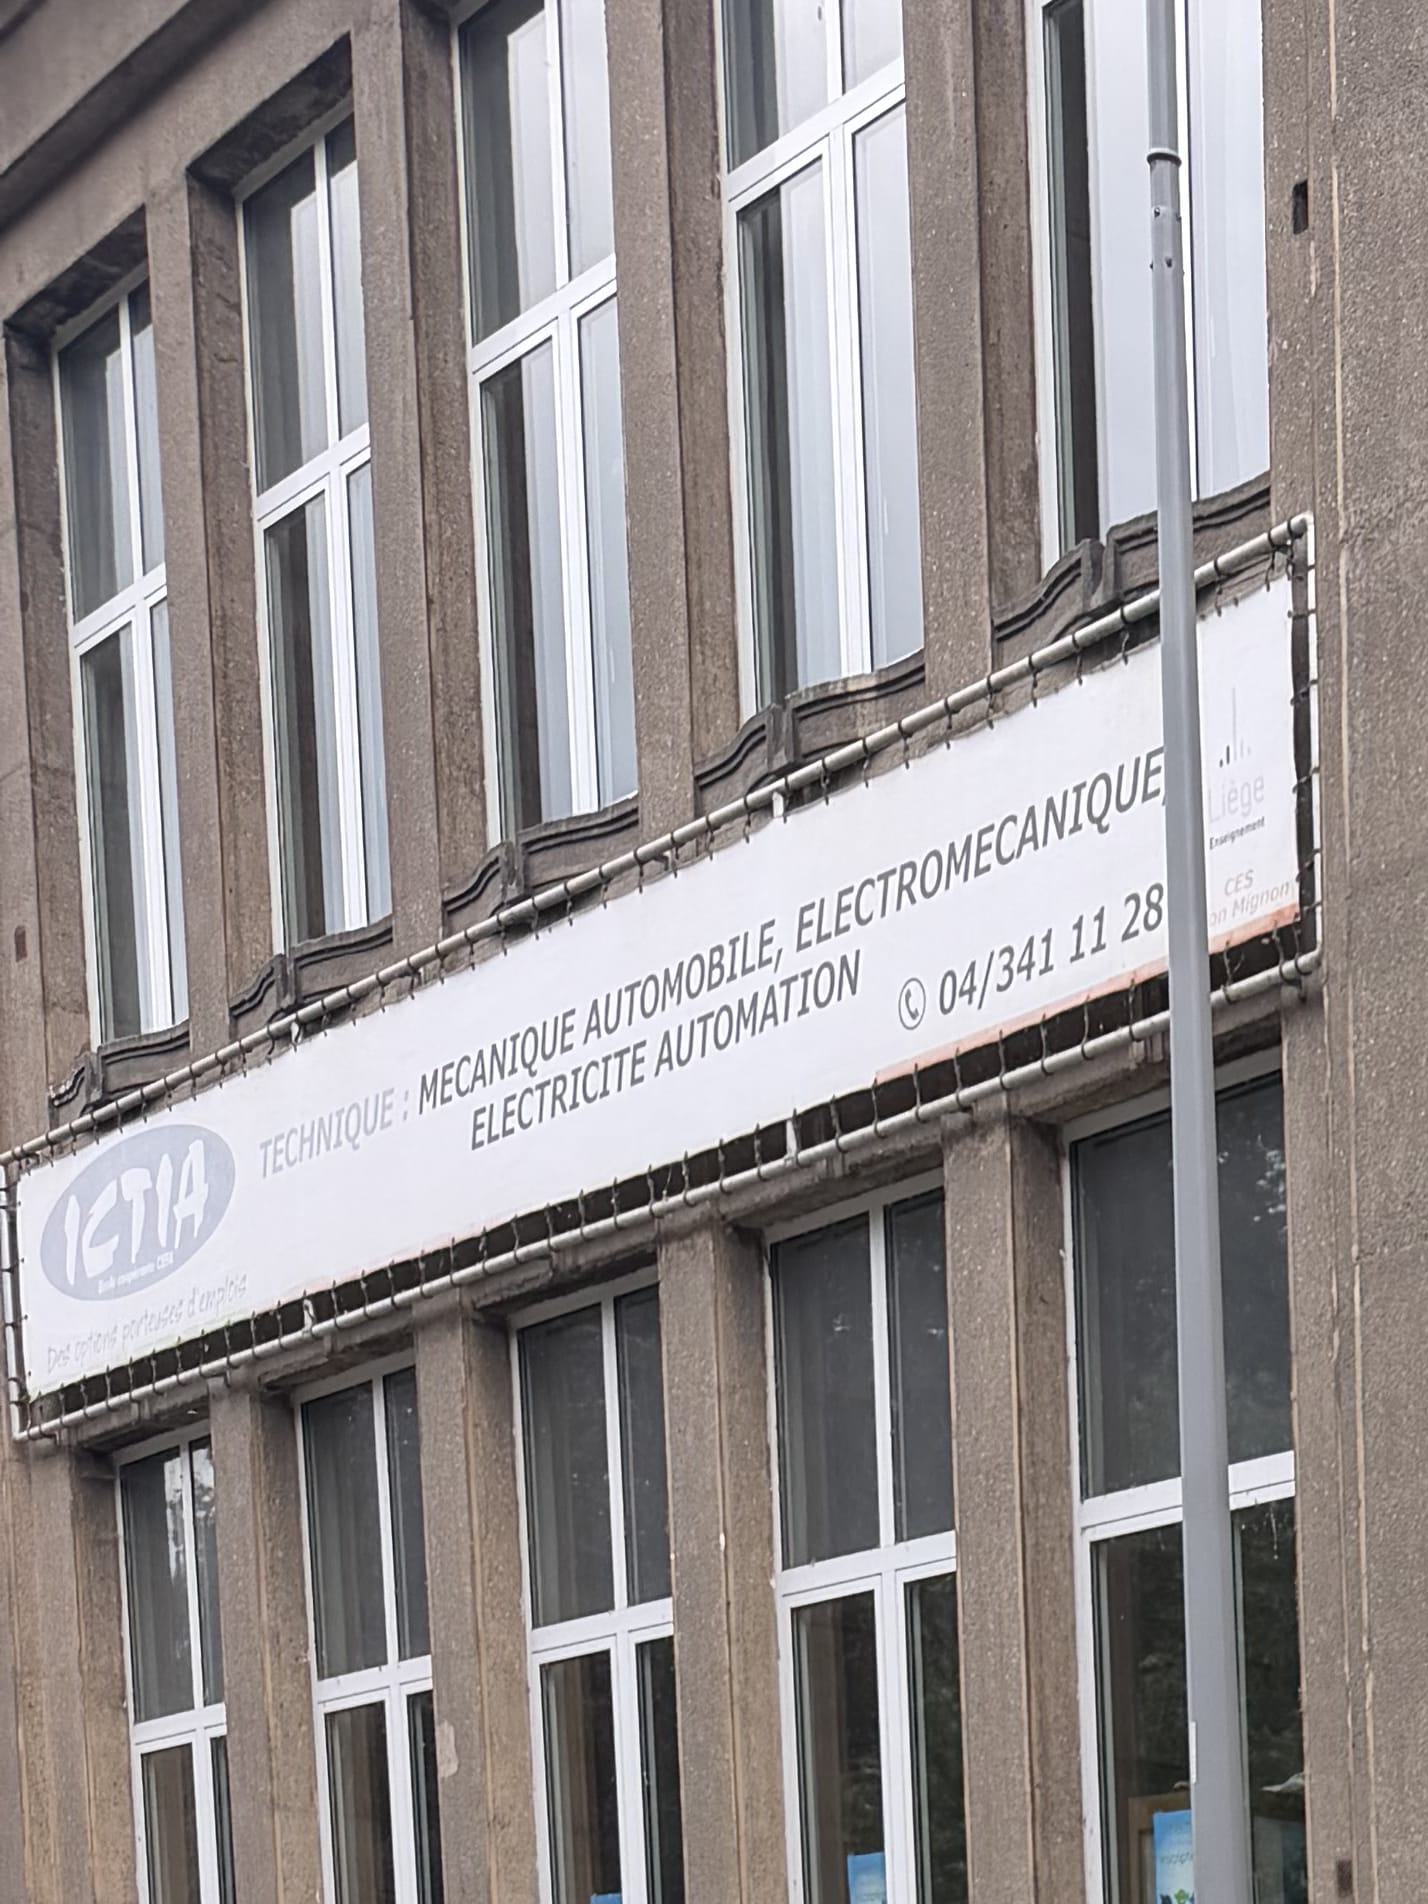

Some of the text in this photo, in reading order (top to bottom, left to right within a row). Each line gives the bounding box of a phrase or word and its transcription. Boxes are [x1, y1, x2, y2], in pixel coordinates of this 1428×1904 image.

[1208, 774, 1265, 824] Liège
[1209, 816, 1265, 850] Enseignement
[1224, 869, 1255, 897] CES
[1232, 881, 1290, 917] Mignon
[939, 883, 1164, 1016] 04/341 11 28
[259, 1087, 395, 1178] TECHNIQUE
[418, 1008, 576, 1115] MECANIQUE
[583, 918, 783, 1045] AUTOMOBILE,
[471, 949, 861, 1151] ELECTRICITE AUTOMATION
